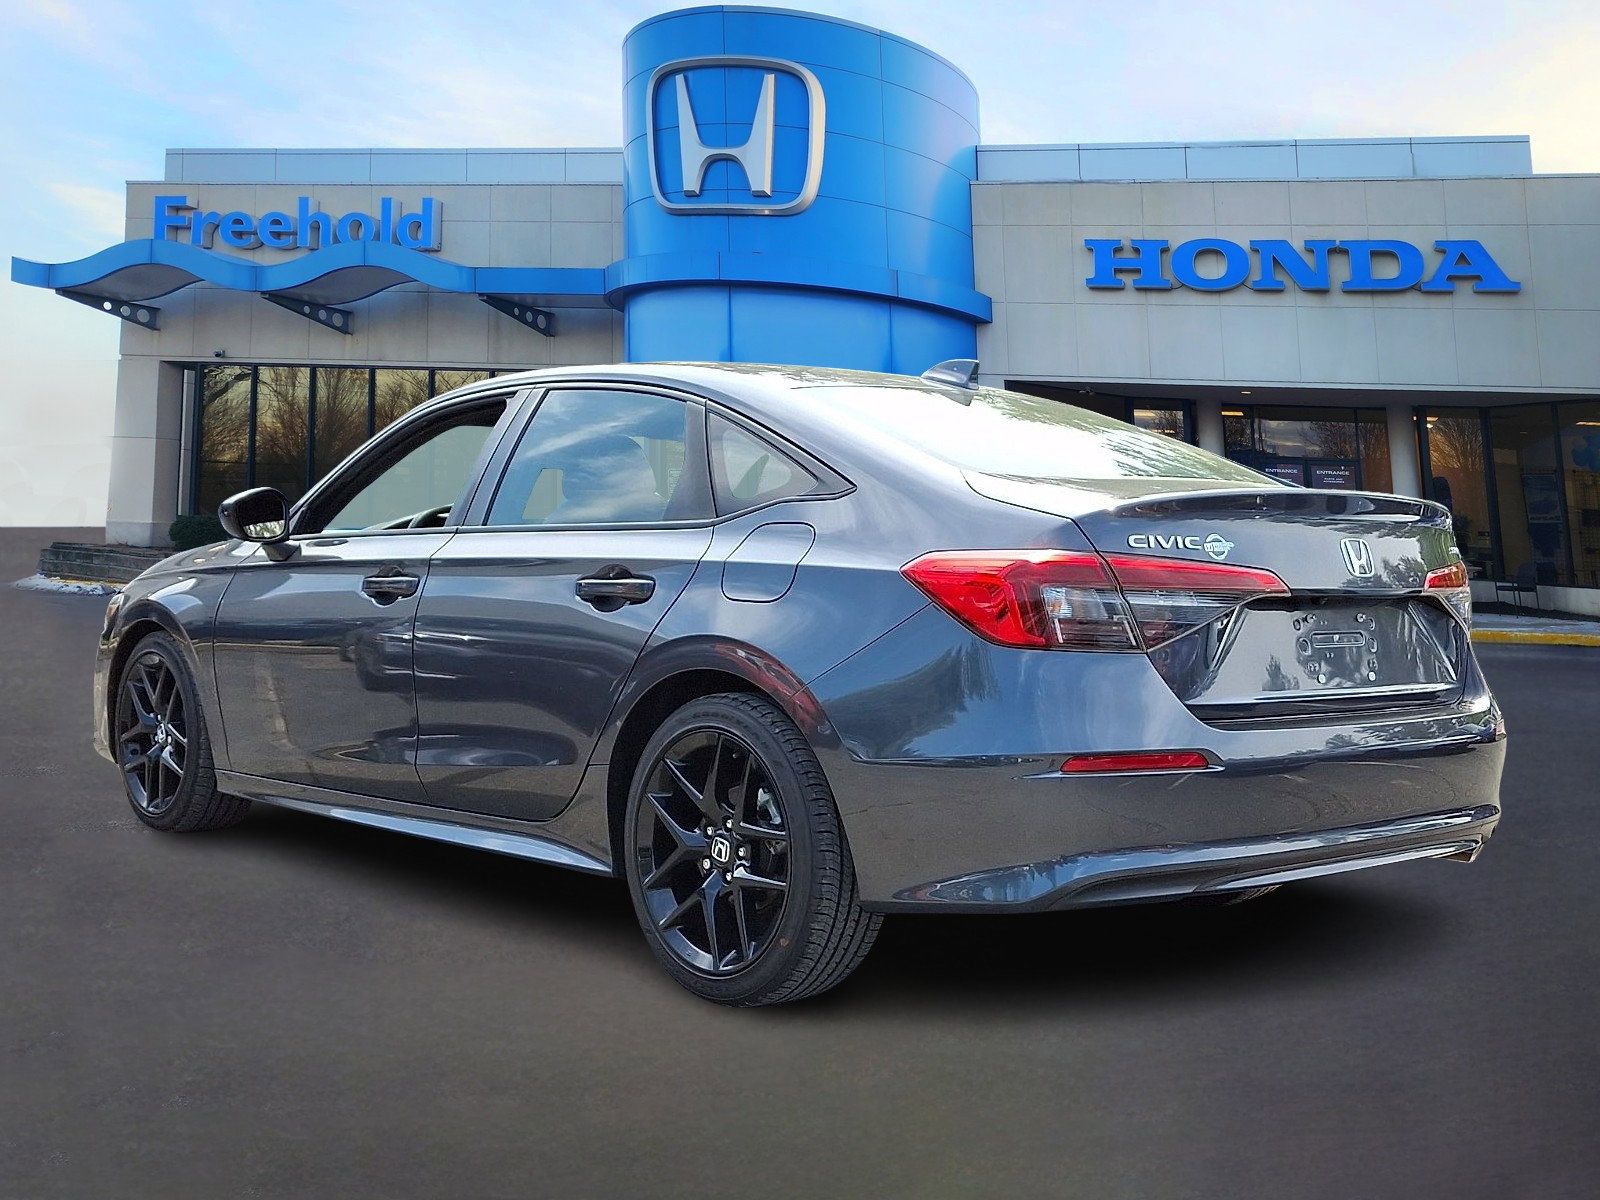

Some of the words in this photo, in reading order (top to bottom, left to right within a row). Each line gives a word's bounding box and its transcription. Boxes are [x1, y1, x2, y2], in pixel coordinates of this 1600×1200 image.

[153, 195, 442, 250] Freehold
[1084, 238, 1522, 292] HONDA
[1127, 534, 1202, 549] CIVIC
